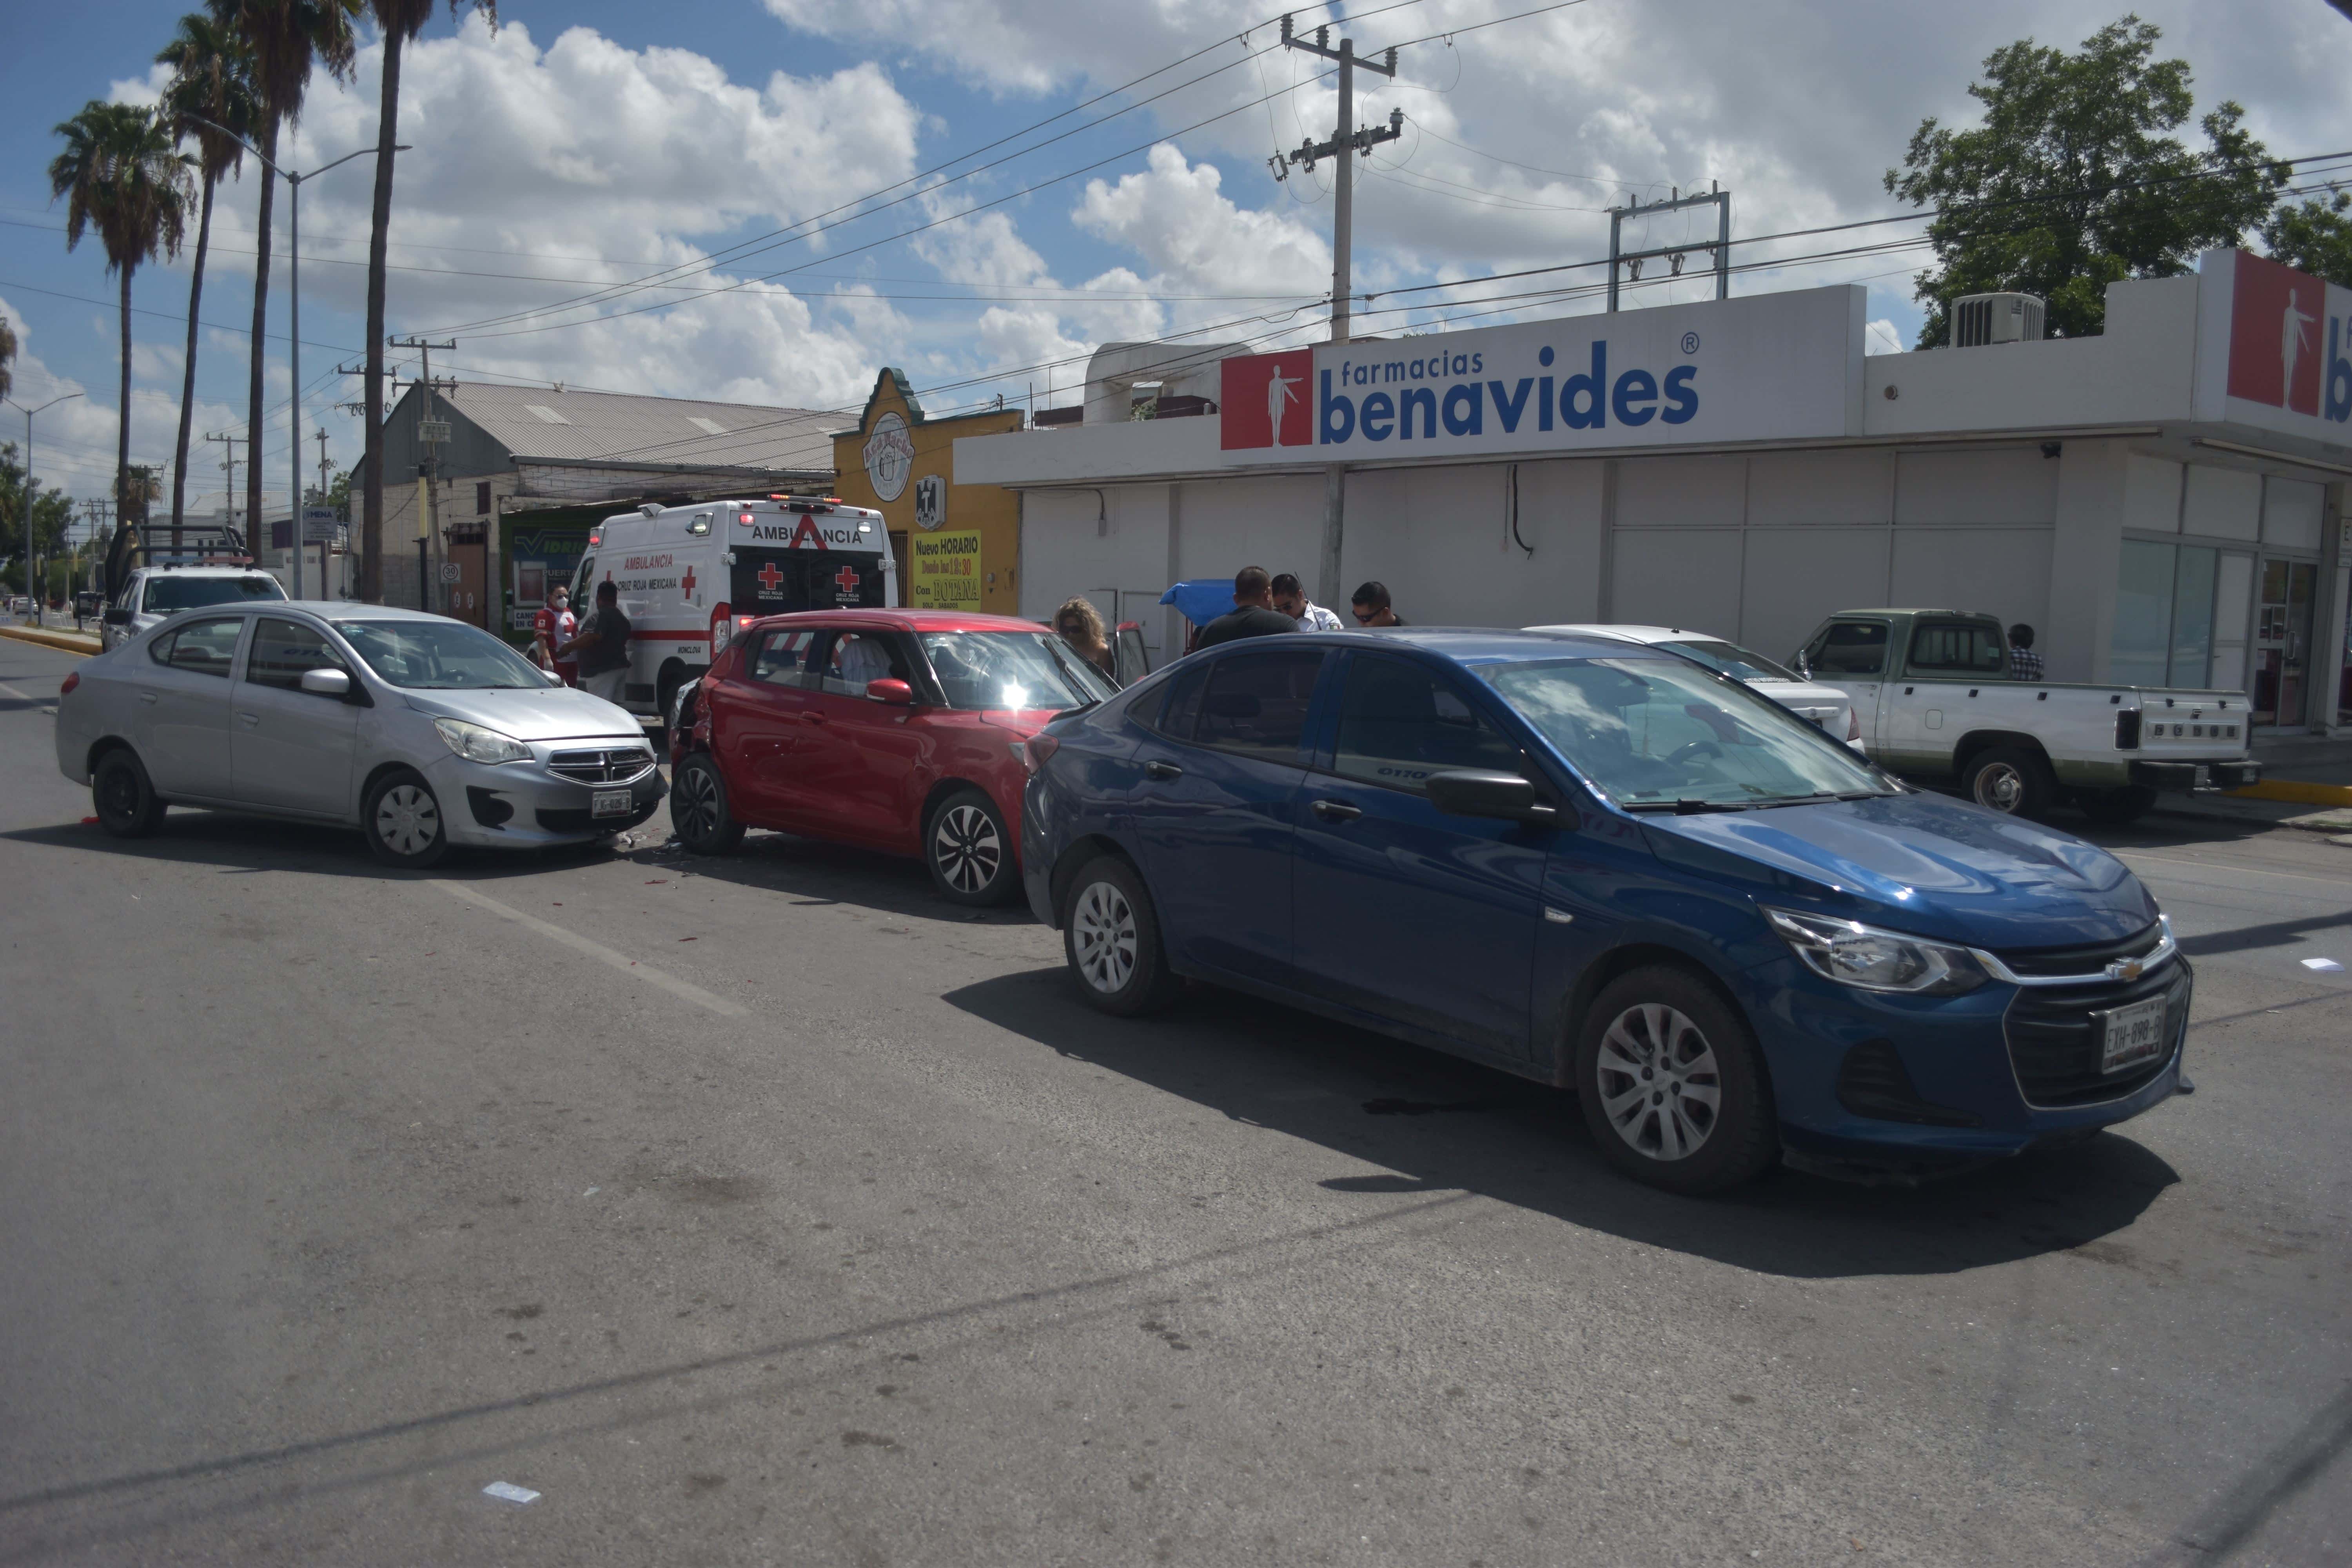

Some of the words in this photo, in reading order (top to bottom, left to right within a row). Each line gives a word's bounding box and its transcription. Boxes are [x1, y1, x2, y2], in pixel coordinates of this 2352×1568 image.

[1342, 350, 1483, 387] farmacias
[1320, 340, 1699, 445] benavides
[752, 526, 862, 544] AMBULANCIA
[916, 539, 939, 556] Nuevo
[941, 536, 978, 555] HORARIO
[624, 554, 673, 570] AMBULANCIA
[922, 560, 939, 574] Desde
[941, 559, 949, 573] las
[949, 557, 971, 576] 12:30
[617, 580, 632, 592] CRUZ
[633, 579, 647, 591] ROJA
[649, 577, 677, 590] MEXICANA
[916, 585, 931, 595] Con
[934, 579, 980, 601] BOTANA
